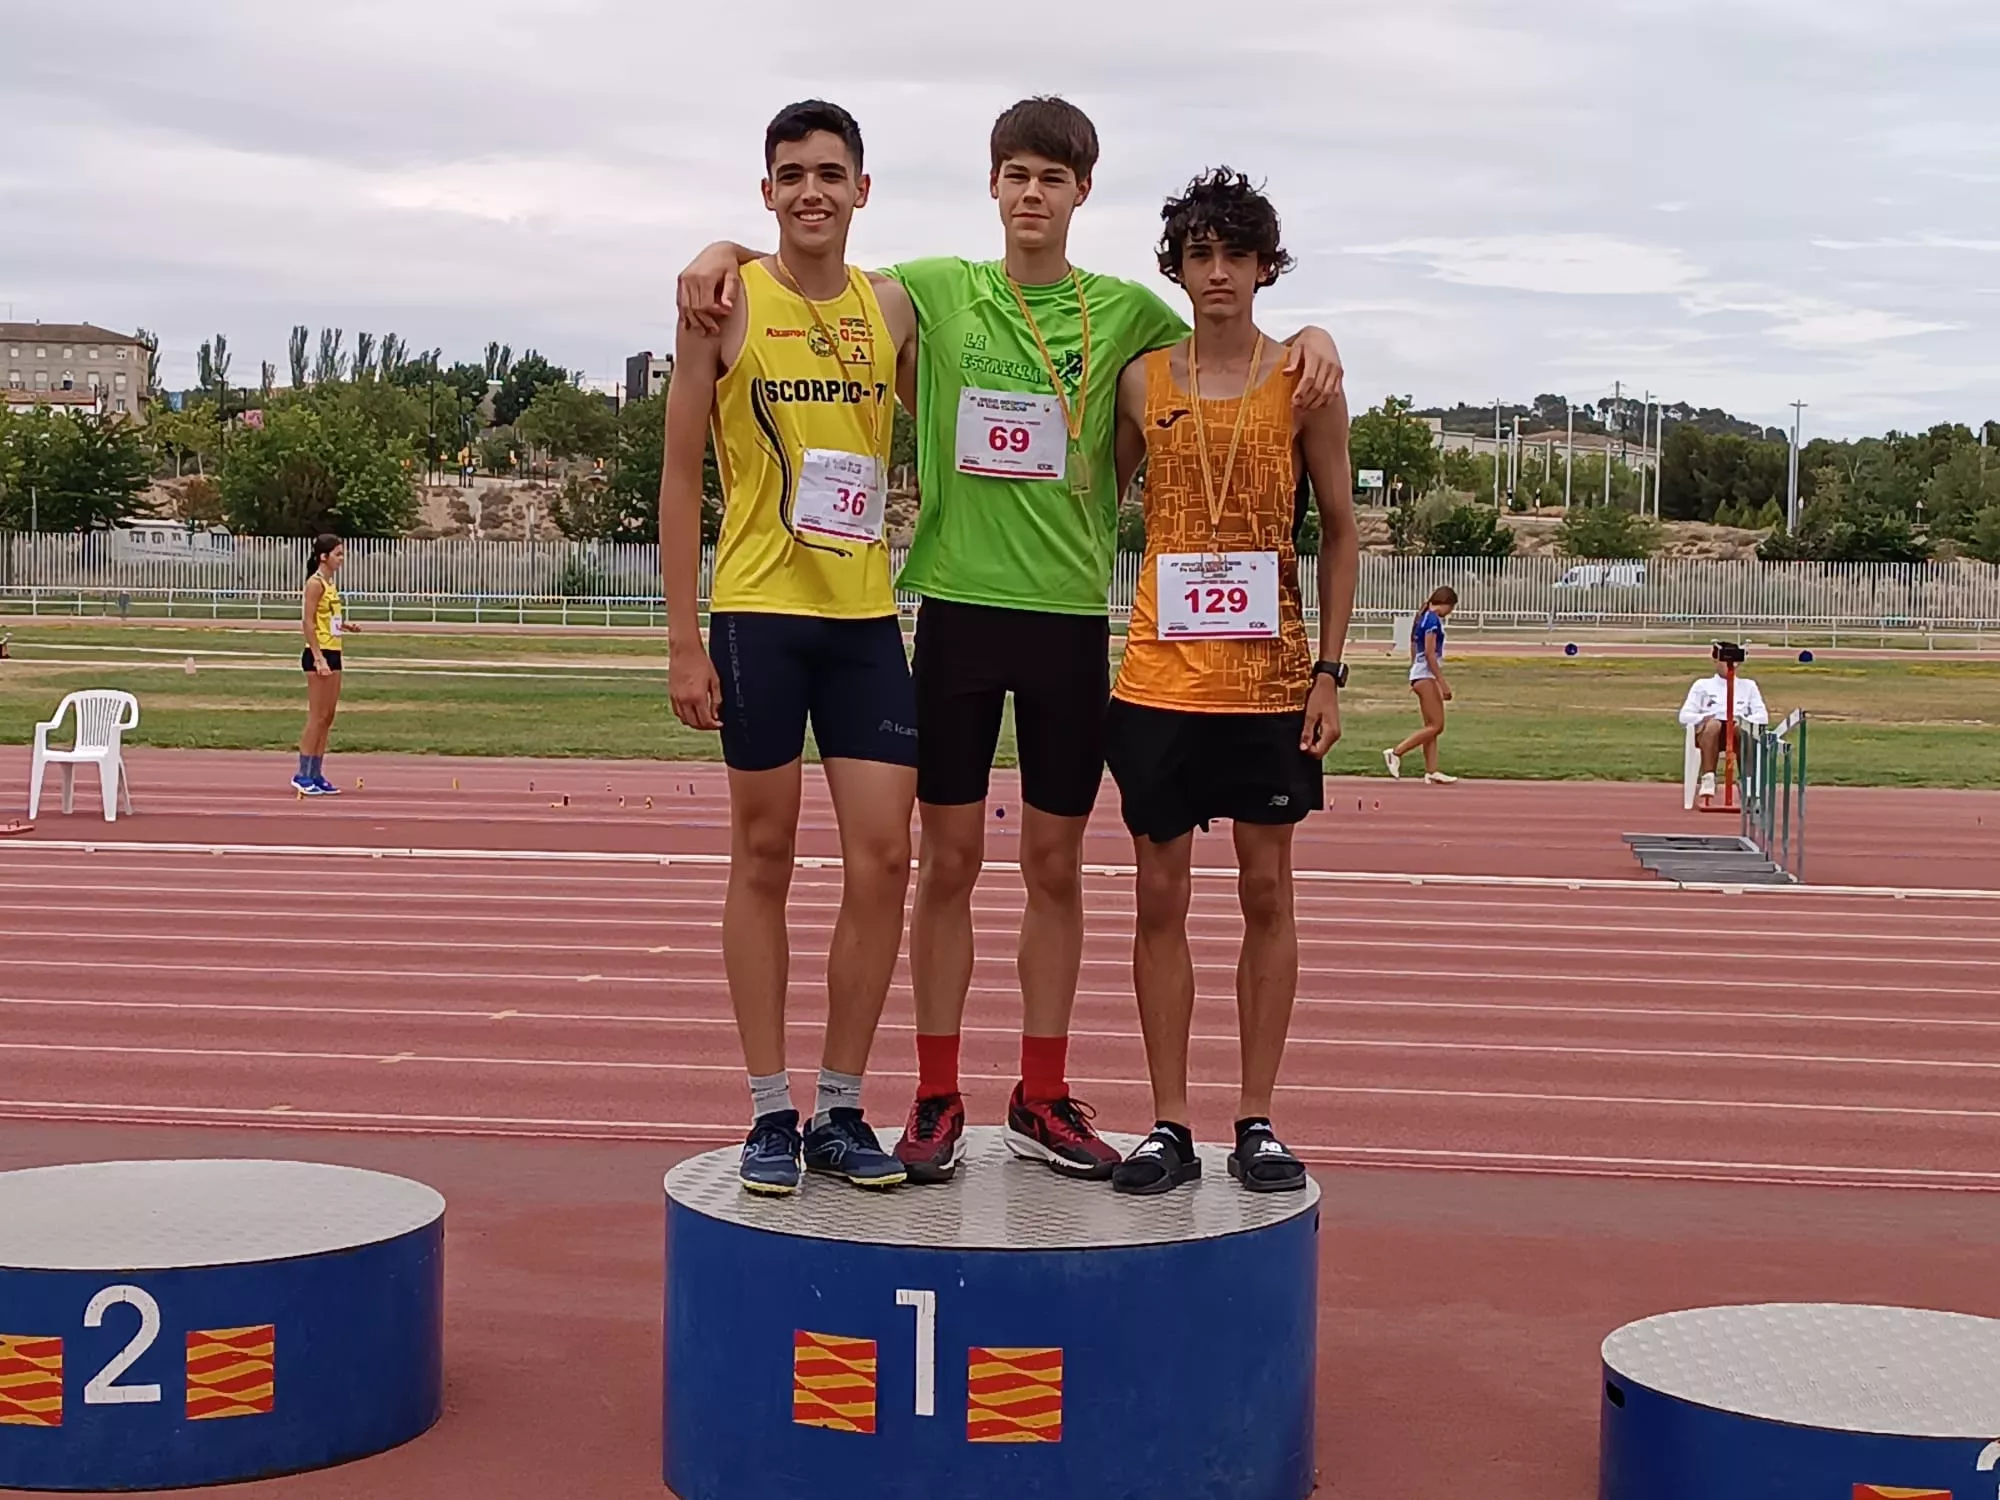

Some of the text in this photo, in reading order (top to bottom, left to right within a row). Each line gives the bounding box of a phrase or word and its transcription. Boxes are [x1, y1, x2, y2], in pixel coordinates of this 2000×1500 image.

[964, 333, 987, 350] LA
[960, 352, 1041, 384] ESTRELLA
[989, 426, 1030, 452] 69
[833, 487, 867, 516] 36
[1184, 587, 1248, 614] 129
[83, 1284, 162, 1405] 2
[895, 1288, 936, 1417] 1
